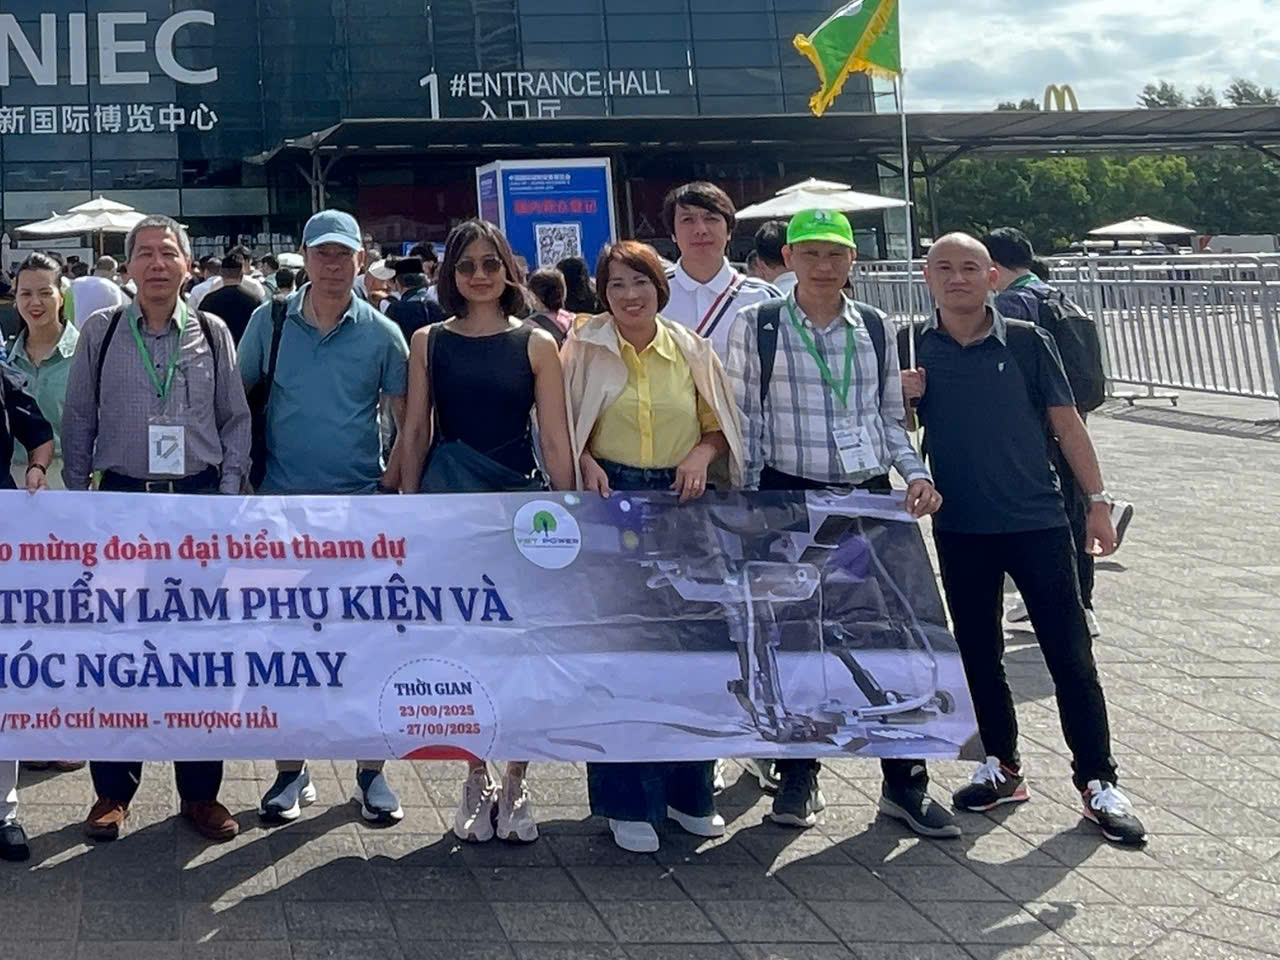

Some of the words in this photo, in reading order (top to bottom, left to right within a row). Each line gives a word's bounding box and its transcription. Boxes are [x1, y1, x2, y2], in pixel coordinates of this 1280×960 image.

[420, 73, 440, 119] 1
[450, 71, 602, 97] #ENTRANCE
[608, 70, 670, 95] HALL
[19, 533, 98, 566] mừng
[103, 533, 171, 561] đoàn
[178, 534, 221, 567] đại
[227, 529, 287, 561] biểu
[291, 534, 365, 559] tham
[372, 533, 407, 566] dự
[136, 577, 230, 622] LÃM
[241, 586, 329, 632] PHỤ
[339, 573, 443, 633] KIỆN
[449, 574, 514, 622] VÀ
[76, 640, 236, 688] NGÀNH
[245, 651, 347, 688] MAY
[394, 678, 433, 696] THỜI
[434, 681, 472, 695] GIAN
[64, 707, 95, 728] CHÍ
[99, 712, 148, 728] MINH
[164, 710, 242, 733] THƯỢNG
[246, 705, 278, 729] HẢI
[399, 704, 475, 718] 23/09/2025
